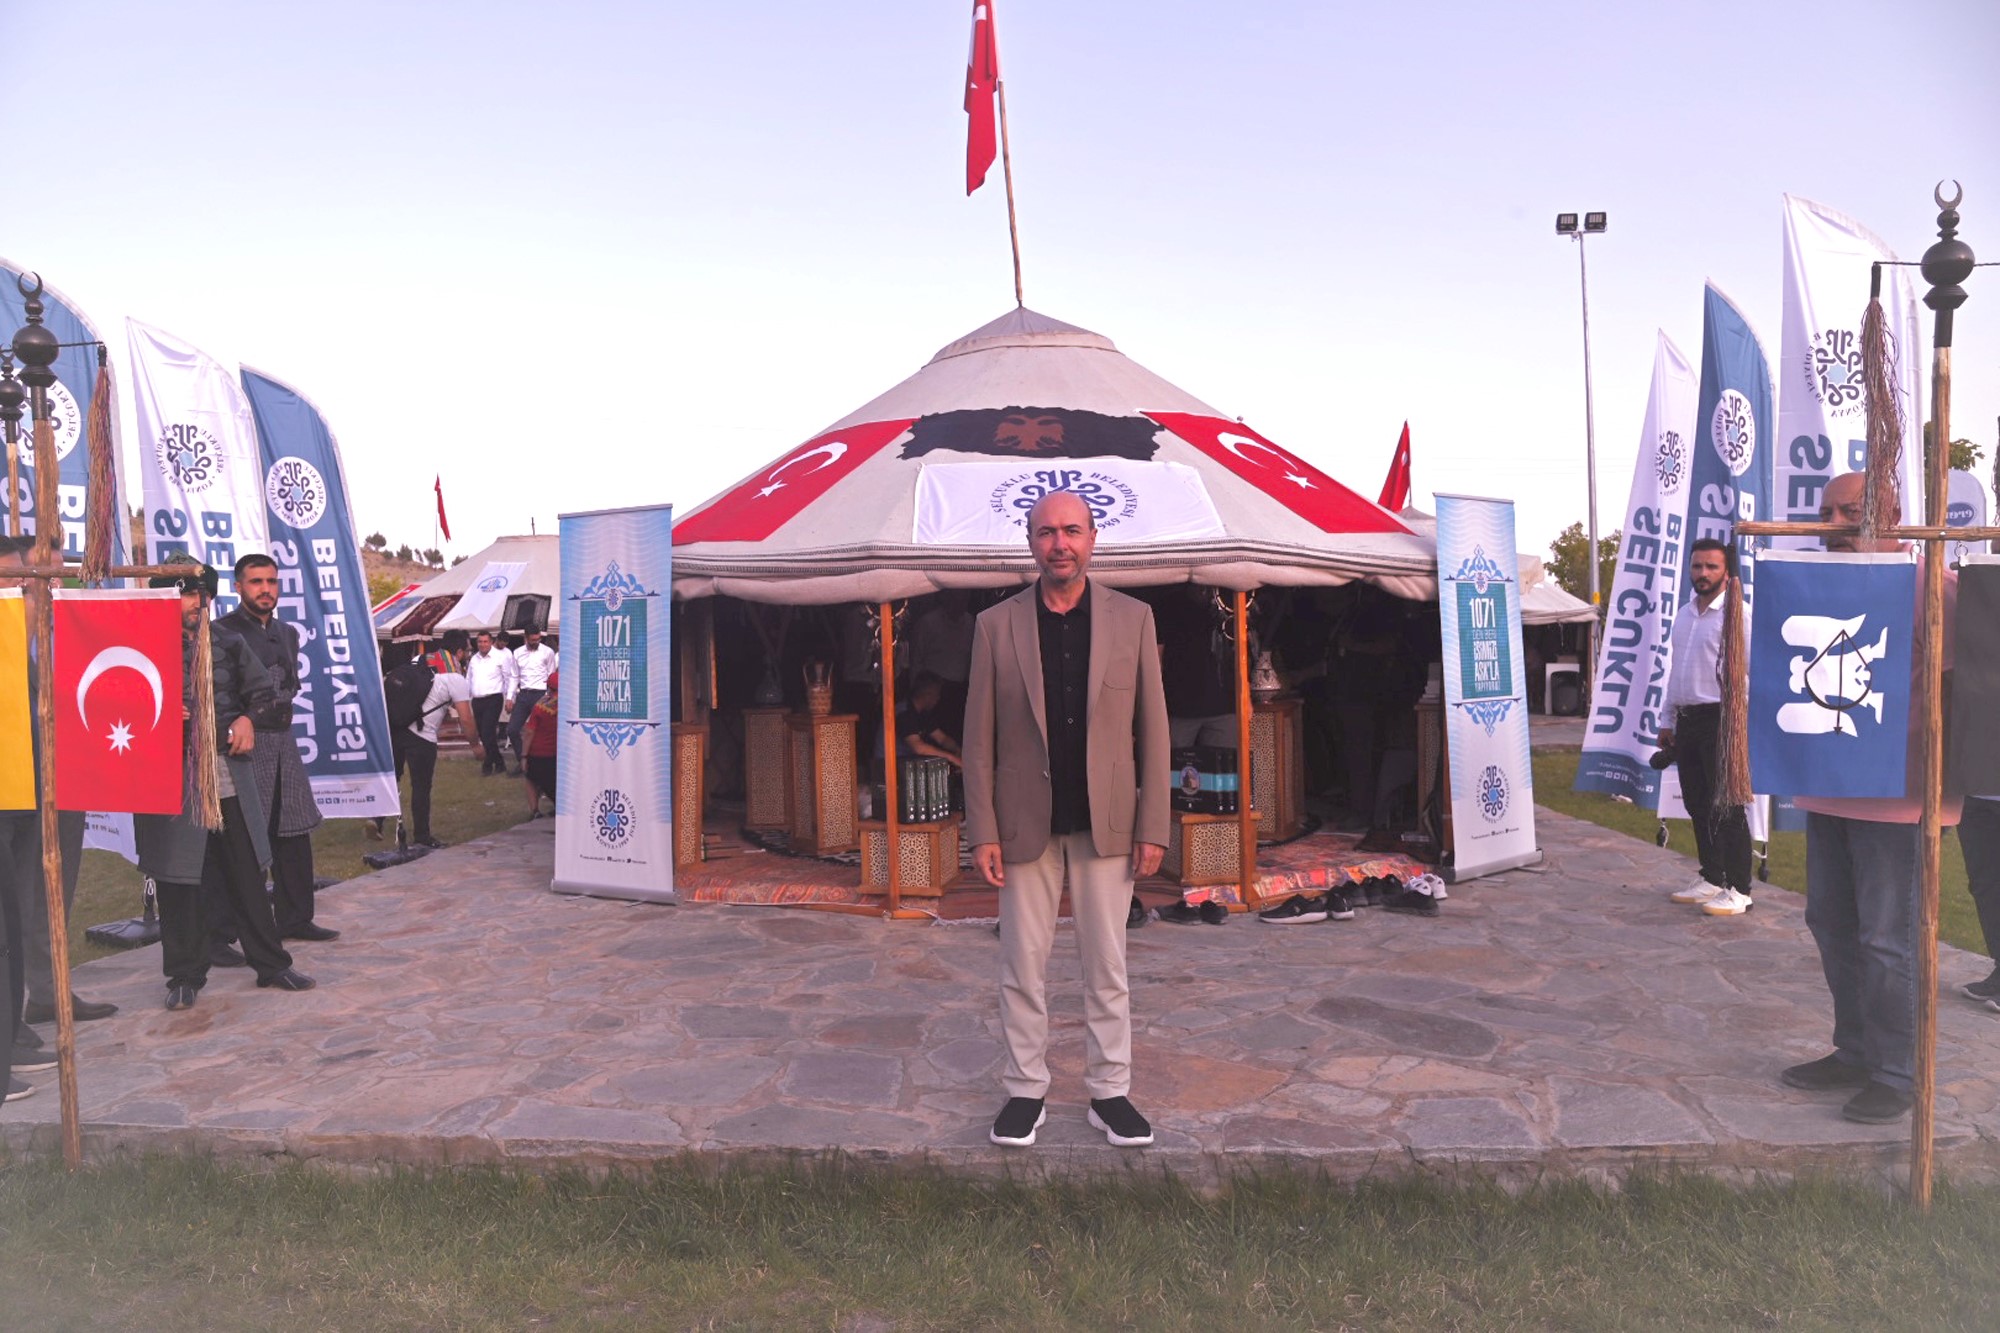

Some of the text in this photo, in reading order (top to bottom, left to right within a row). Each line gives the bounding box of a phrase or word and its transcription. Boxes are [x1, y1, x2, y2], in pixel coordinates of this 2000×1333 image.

[991, 472, 1139, 518] SELÇUKLU BELEDİYESİ
[1097, 517, 1121, 530] 989
[1469, 598, 1497, 628] 1071
[595, 615, 631, 647] 1071
